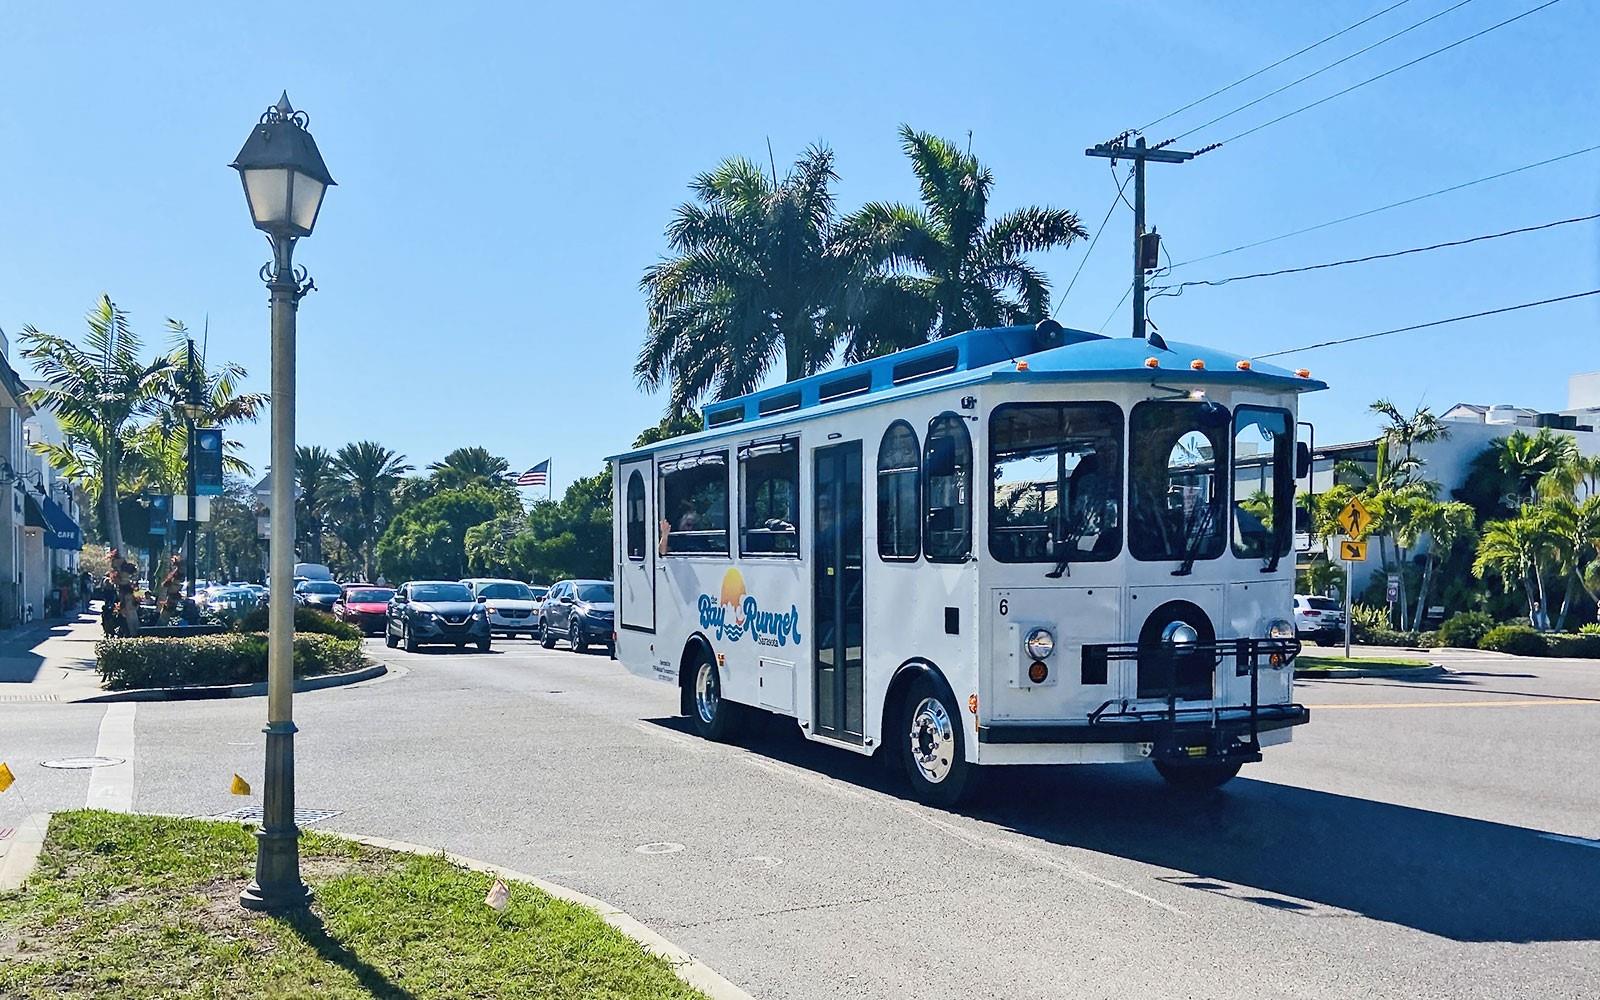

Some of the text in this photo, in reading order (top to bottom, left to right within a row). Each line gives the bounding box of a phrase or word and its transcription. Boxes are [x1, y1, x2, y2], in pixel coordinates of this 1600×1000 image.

[57, 531, 75, 539] CAFE
[999, 598, 1009, 616] 6
[698, 594, 801, 646] Bay Runner
